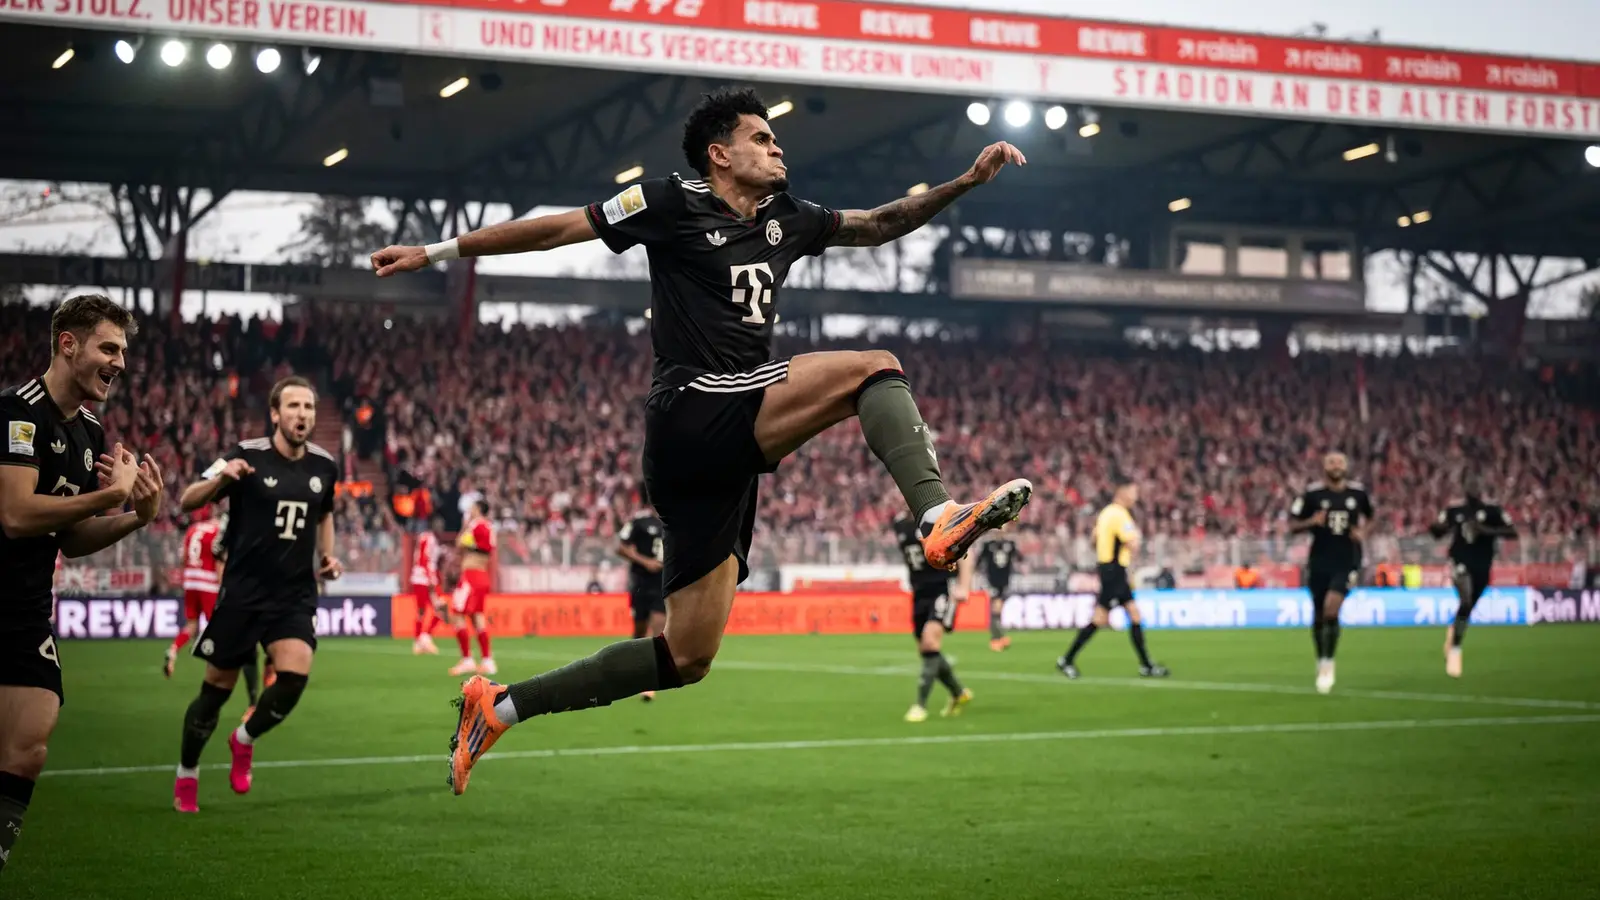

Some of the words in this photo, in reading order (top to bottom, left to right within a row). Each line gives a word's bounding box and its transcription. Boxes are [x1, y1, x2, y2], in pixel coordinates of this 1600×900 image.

[168, 0, 260, 28] UNSER
[269, 4, 375, 36] VEREIN.
[744, 1, 819, 29] REWE
[860, 9, 933, 39] REWE
[481, 20, 534, 48] UND
[543, 26, 651, 57] NIEMALS
[661, 34, 807, 69] VERGESSEN:
[822, 46, 904, 75] EISERN
[969, 18, 1040, 48] REWE
[1078, 27, 1147, 56] REWE
[1197, 37, 1259, 65] raisin
[1303, 46, 1362, 73] raisin
[1403, 55, 1461, 82] raisin
[1503, 63, 1558, 88] raisin
[1113, 67, 1253, 104] STADION
[1271, 79, 1311, 109] AN
[1327, 84, 1381, 114] DER
[1401, 89, 1490, 124] ALTEN
[1506, 97, 1600, 133] FORST
[730, 262, 774, 324] T
[275, 500, 308, 540] T
[57, 598, 179, 639] REWE
[315, 598, 377, 636] arkt
[1001, 594, 1097, 629] REWE
[1525, 588, 1577, 624] Dein
